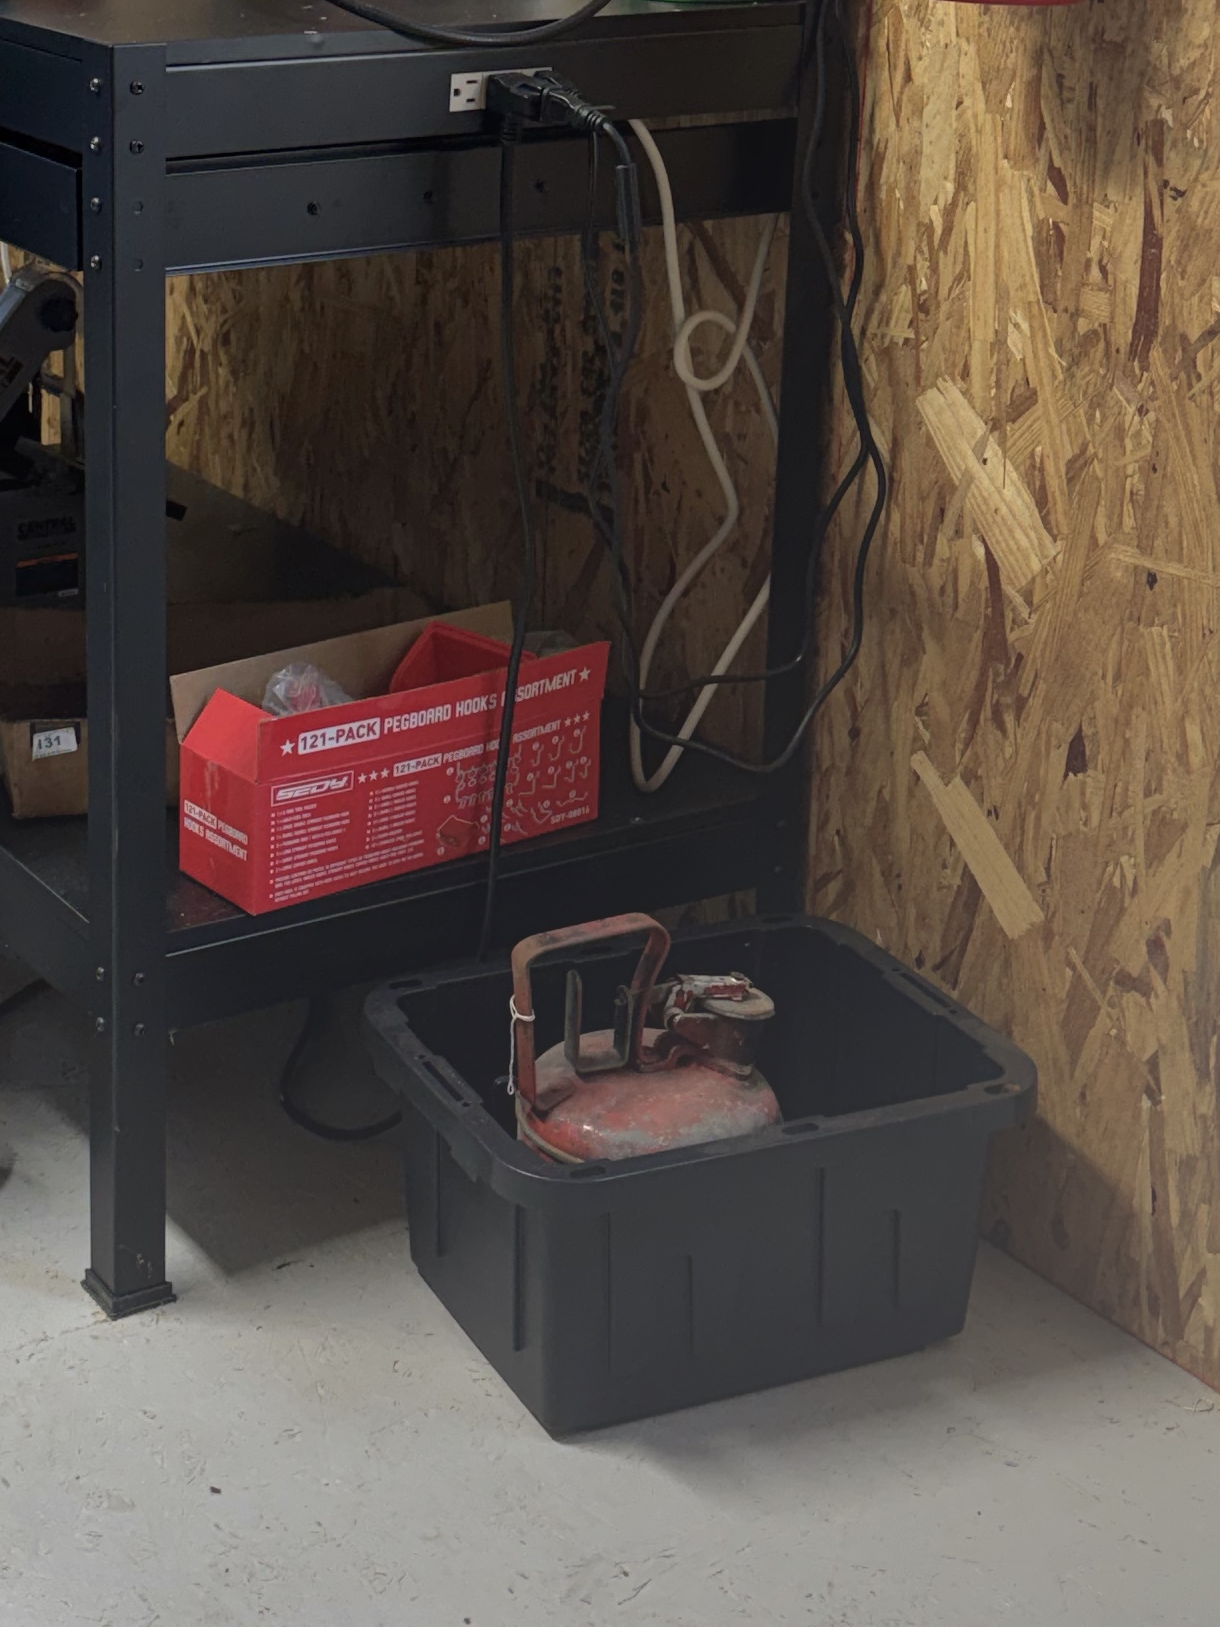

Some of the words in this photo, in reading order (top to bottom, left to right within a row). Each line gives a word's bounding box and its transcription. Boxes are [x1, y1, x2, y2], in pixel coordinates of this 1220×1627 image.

[300, 721, 378, 751] 121-PACK
[384, 705, 453, 736] PEGBOARD
[455, 691, 497, 718] HOOKS
[500, 669, 577, 707] SORTMENT
[396, 756, 439, 774] 121-PACK
[443, 744, 484, 763] PEGBOARD
[513, 719, 561, 743] ASSORTMENT
[276, 776, 348, 801] SEDY
[185, 802, 216, 826] 121-PACK
